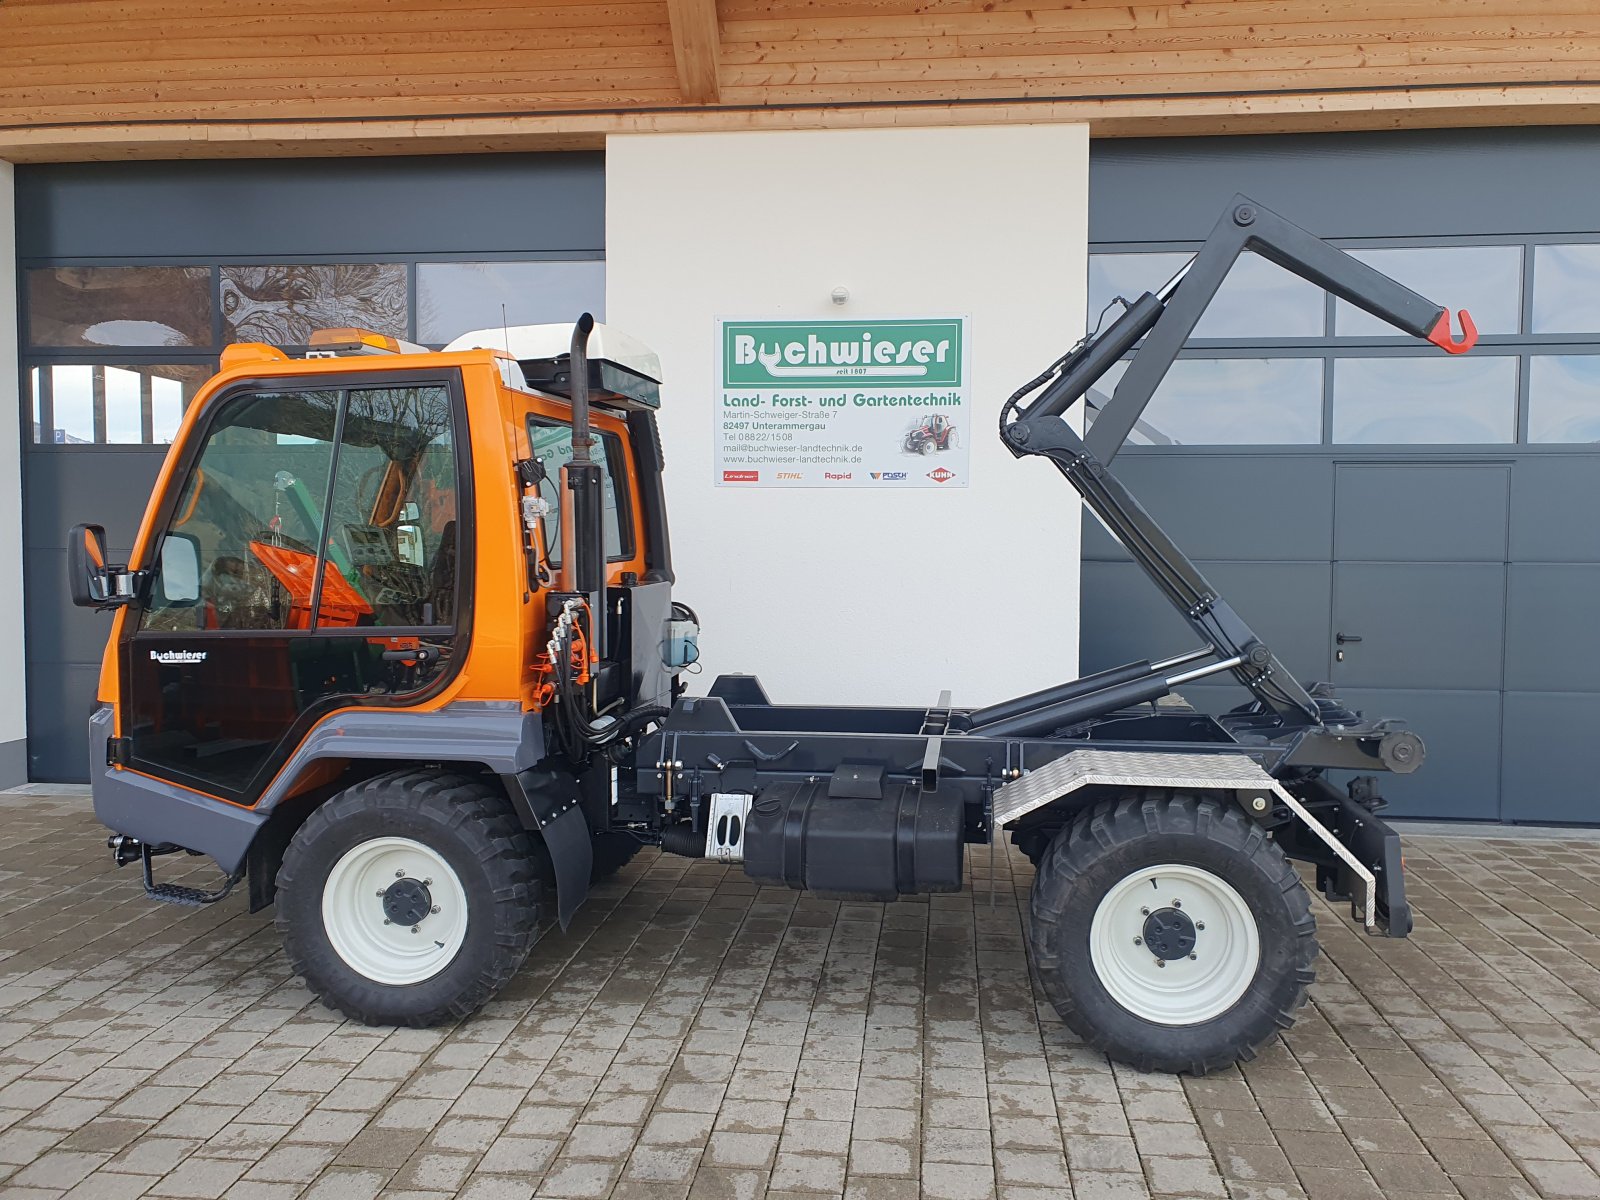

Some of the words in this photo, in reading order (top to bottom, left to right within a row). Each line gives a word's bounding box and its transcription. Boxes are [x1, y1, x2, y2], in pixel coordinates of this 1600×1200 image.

[735, 332, 950, 366] Buchwieser
[723, 394, 766, 407] Land-
[772, 394, 813, 407] Forst-
[819, 394, 847, 407] und
[853, 392, 961, 407] Gartentechnik
[723, 410, 830, 421] Martin-Schweiger-Straße
[832, 410, 838, 419] 7
[723, 421, 750, 430] 82497
[752, 421, 826, 432] Unterammergau
[723, 432, 736, 441] Tel
[738, 432, 793, 441] 08822/1508
[723, 443, 863, 453] mail@buchwieser-landtechnik.de
[723, 455, 862, 464] www.buchwieser-landtechnik.de
[825, 472, 852, 480] Rapid
[150, 650, 207, 661] Buchwieser
